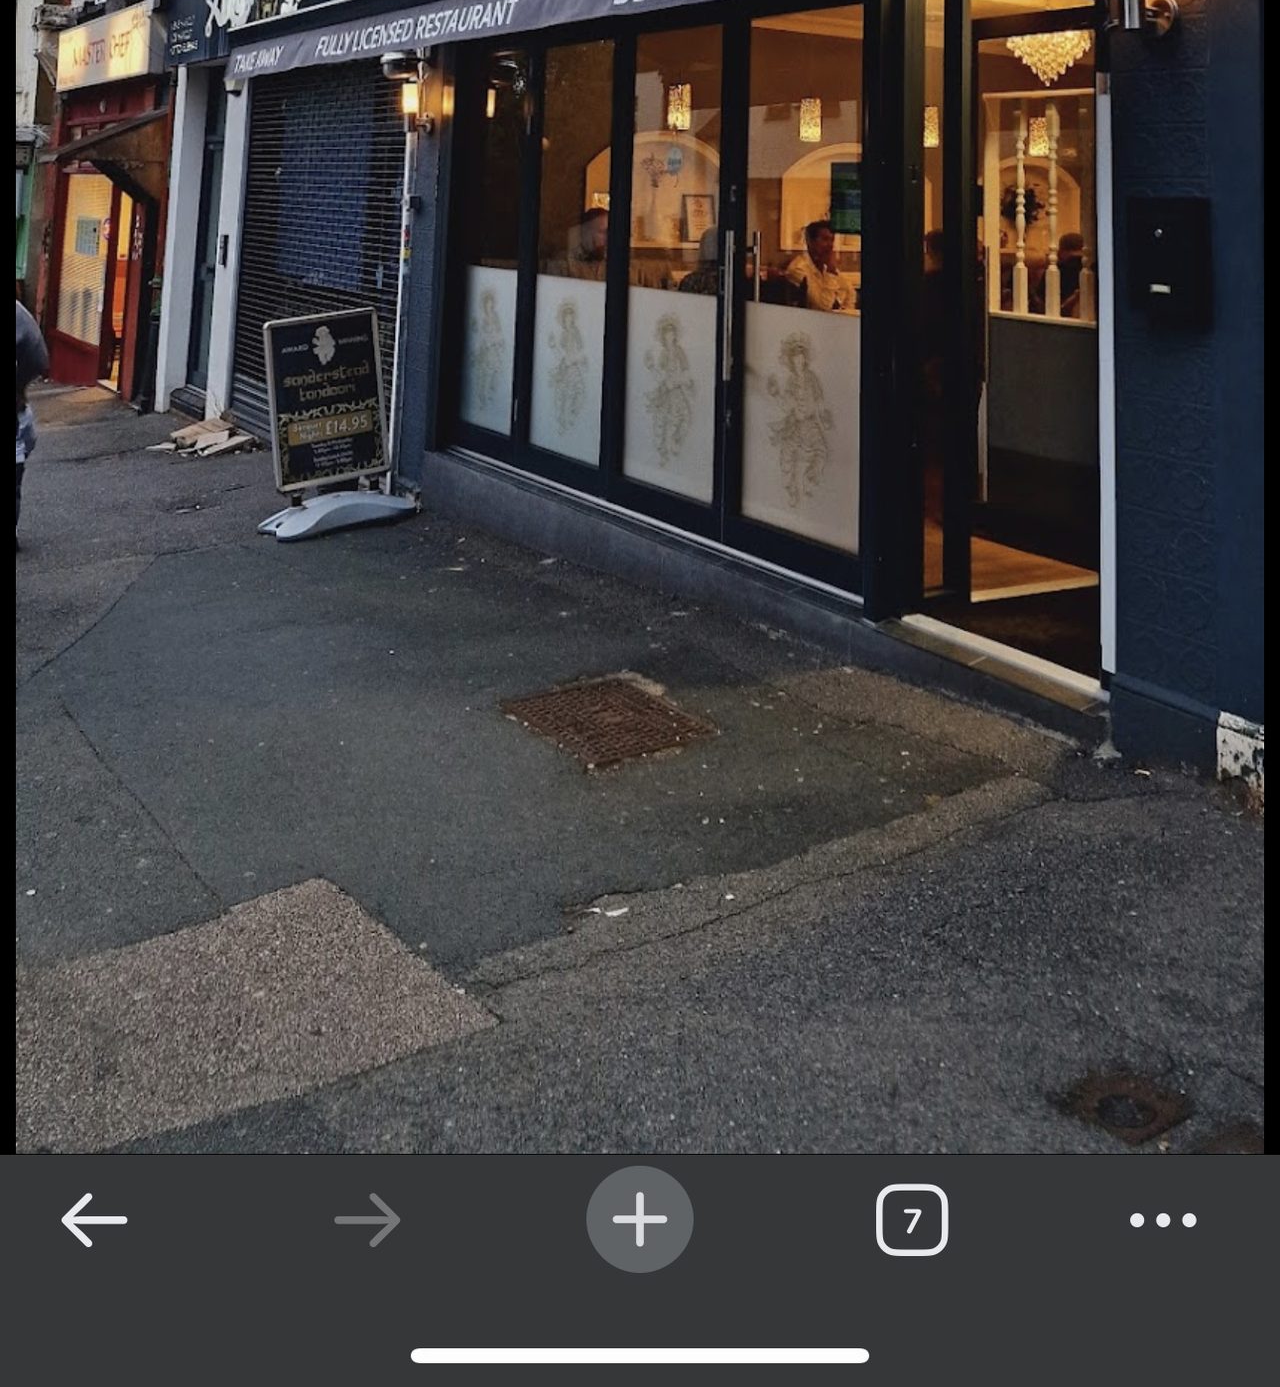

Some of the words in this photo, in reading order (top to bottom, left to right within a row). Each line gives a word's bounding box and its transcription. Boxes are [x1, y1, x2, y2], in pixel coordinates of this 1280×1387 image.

[315, 31, 355, 58] FULLY
[351, 17, 414, 51] LICENSED
[326, 414, 369, 435] £14.95
